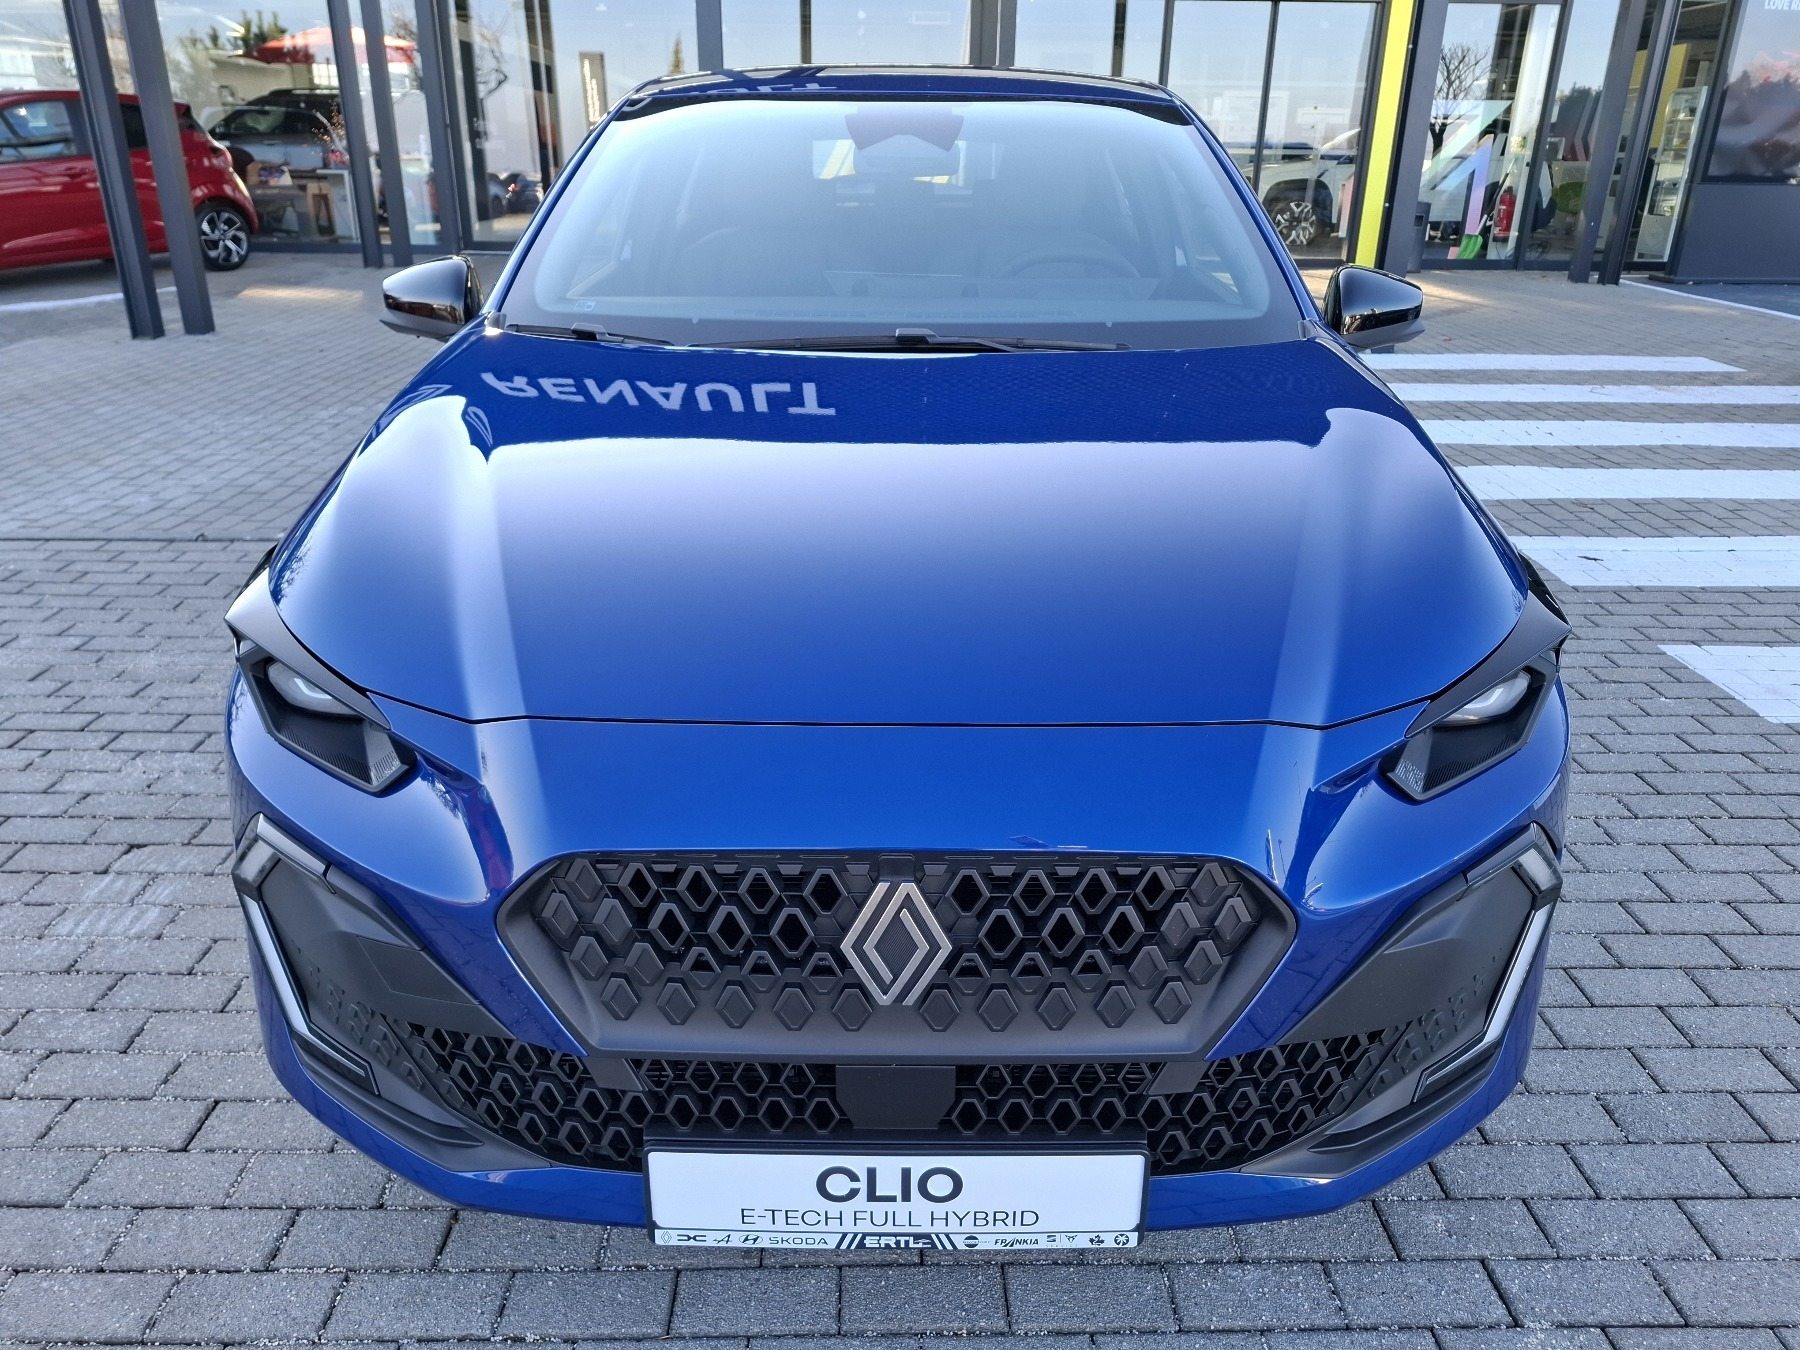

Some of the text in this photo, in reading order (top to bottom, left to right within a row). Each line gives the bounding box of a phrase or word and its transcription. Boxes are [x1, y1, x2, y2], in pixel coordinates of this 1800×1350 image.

[1764, 0, 1790, 10] LOVE
[815, 1165, 964, 1204] CLIO
[740, 1208, 1040, 1227] E-TECH FULL HYBRID
[994, 1238, 1039, 1248] FRANKIA
